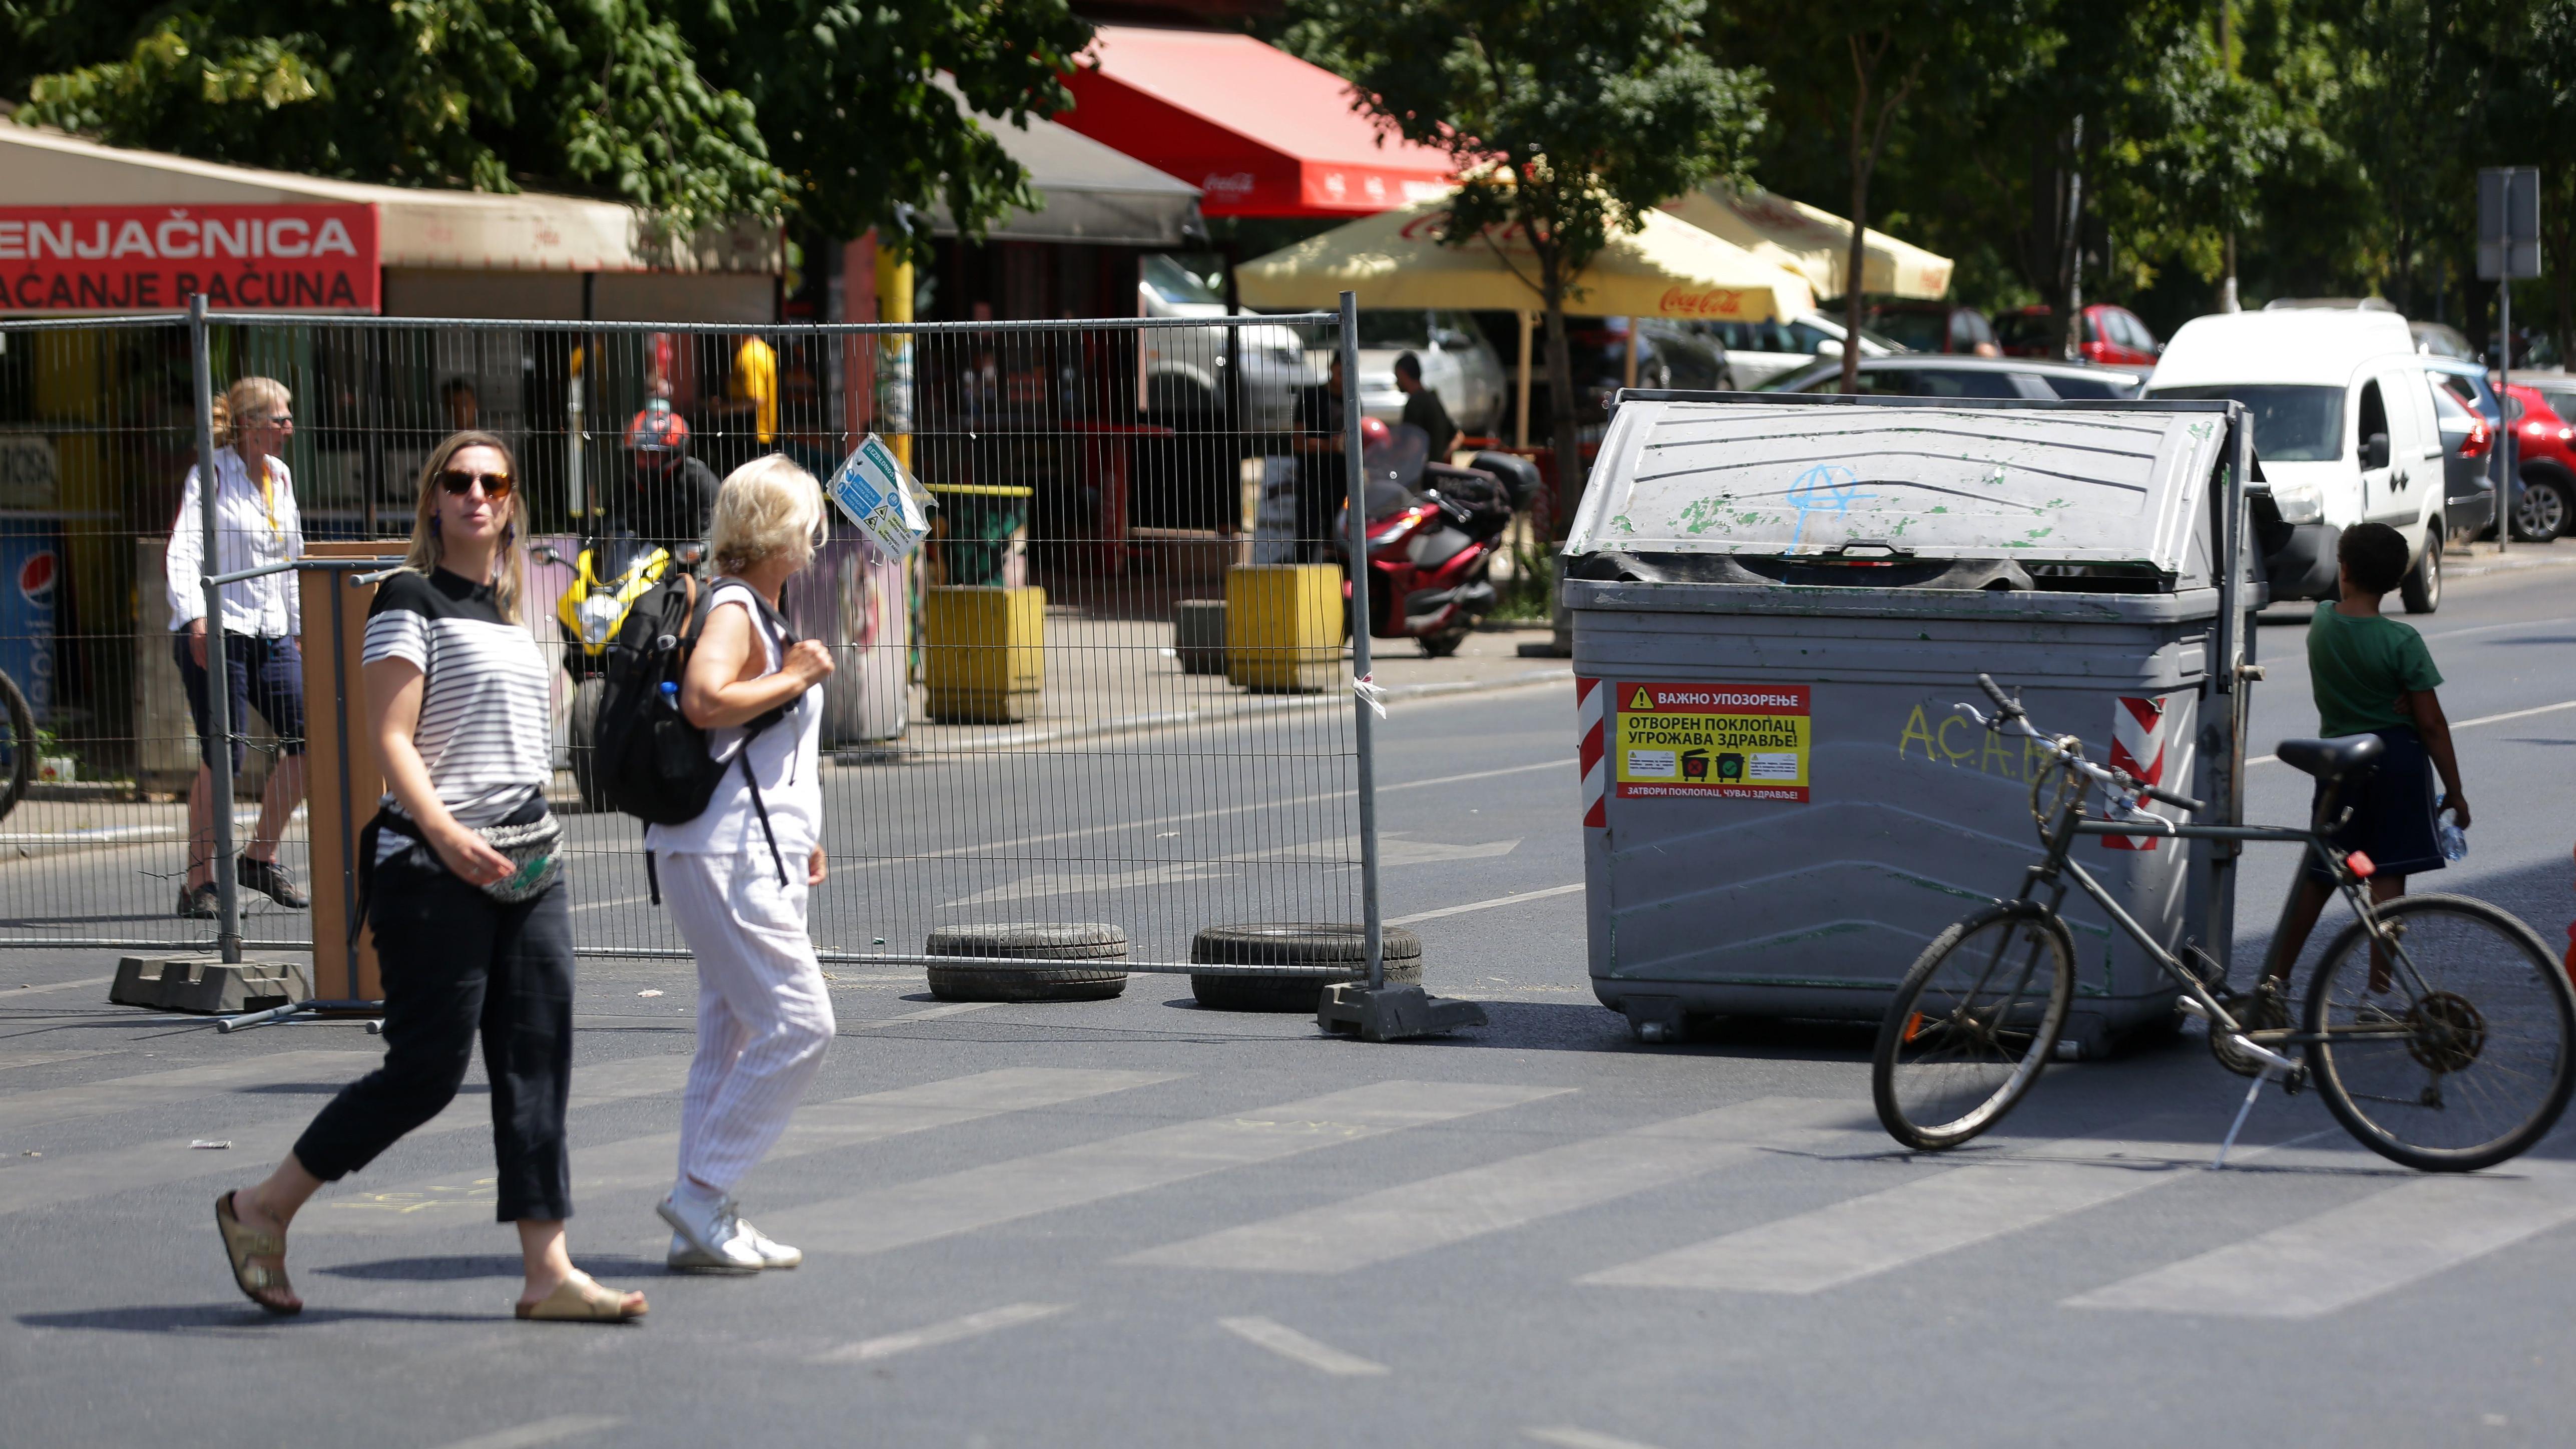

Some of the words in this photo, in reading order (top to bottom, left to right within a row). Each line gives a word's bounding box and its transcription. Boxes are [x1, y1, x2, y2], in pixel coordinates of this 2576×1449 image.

[0, 208, 357, 259] ENJAČNICA
[177, 262, 357, 307] RAČUNA
[1658, 692, 1709, 704] ВАЖНО
[1712, 693, 1798, 706] УПОЗОРЕЊЕ
[1629, 717, 1700, 730] ОТВОРЕН
[1705, 718, 1795, 735] ПОКЛОПАЦ
[1628, 731, 1714, 745] УГРОЖАВА
[1718, 734, 1798, 749] ЗДРАВЉЕ!
[1627, 787, 1667, 795] ЗАТВОРИ
[1723, 789, 1751, 798] ЧУВАЈ
[1752, 790, 1798, 800] ЗДРАВЉЕ!
